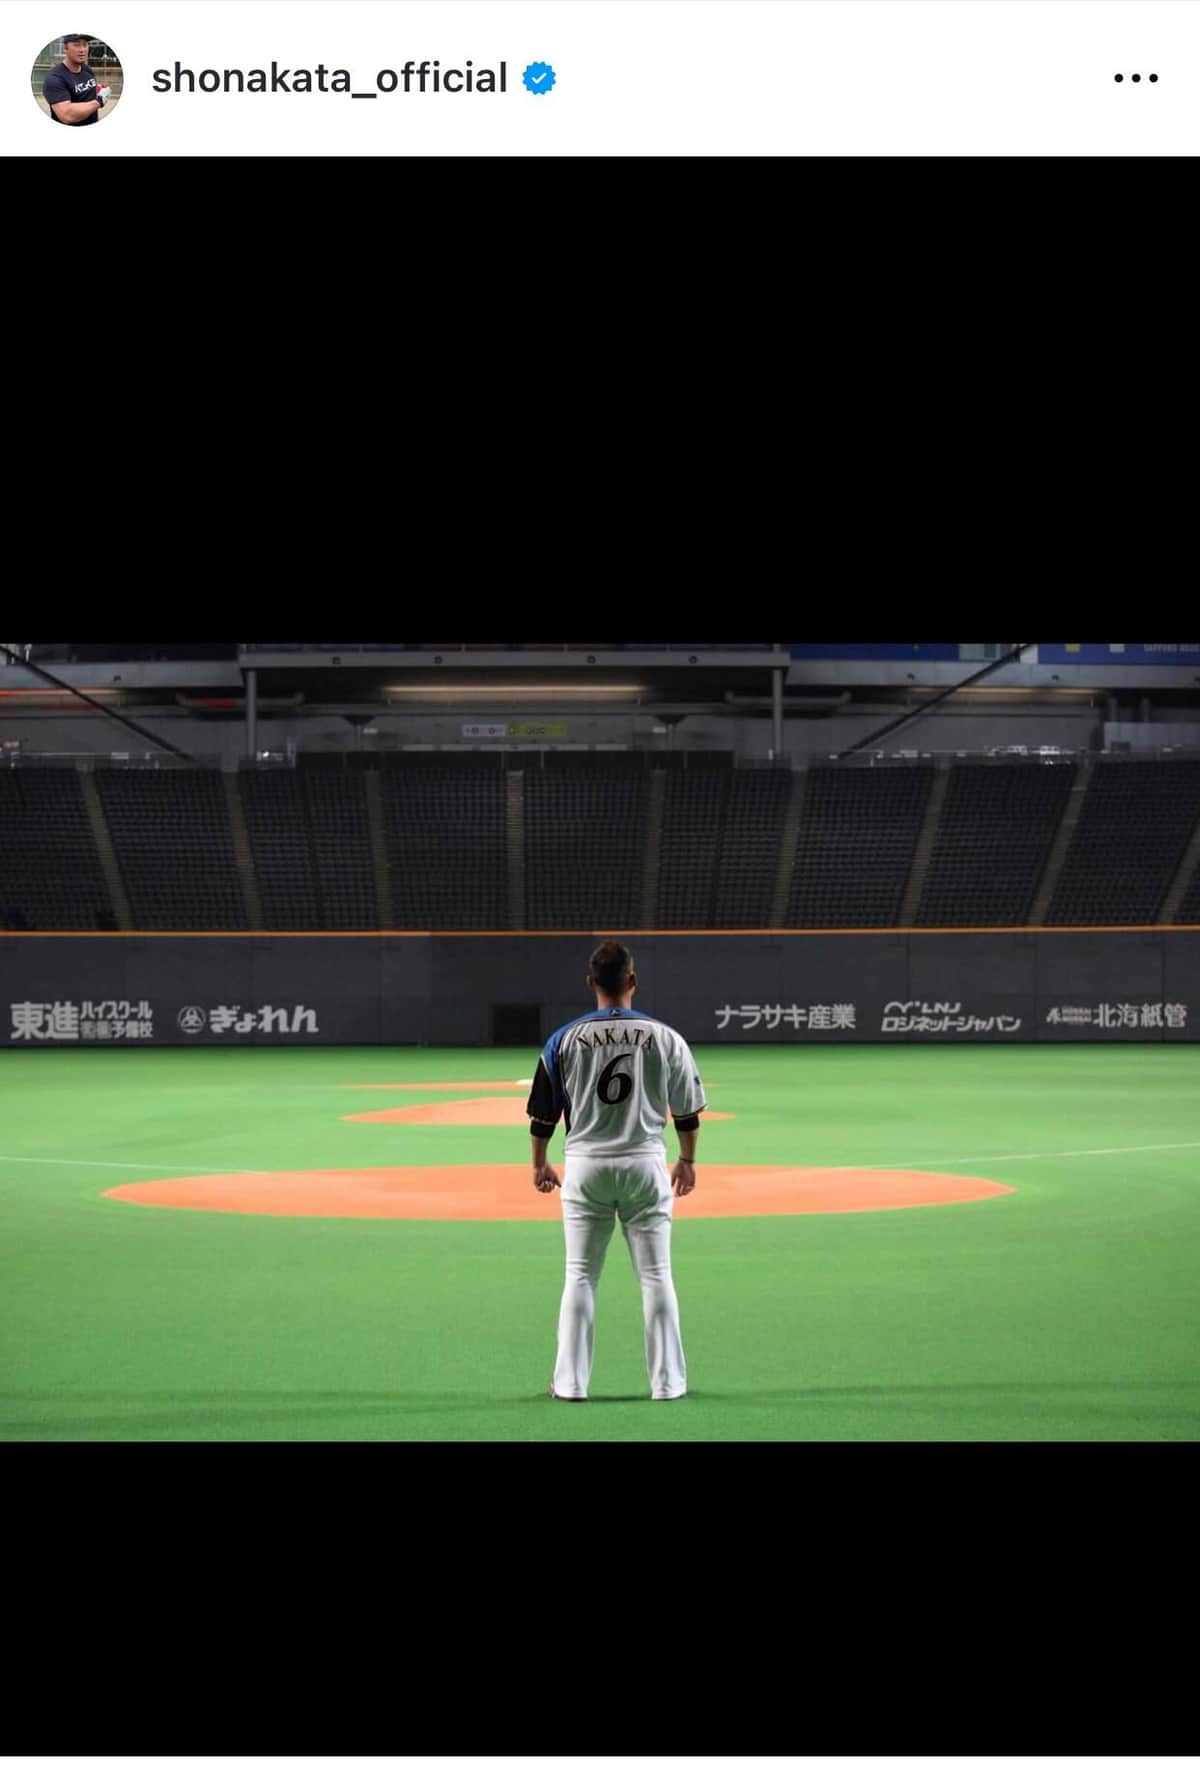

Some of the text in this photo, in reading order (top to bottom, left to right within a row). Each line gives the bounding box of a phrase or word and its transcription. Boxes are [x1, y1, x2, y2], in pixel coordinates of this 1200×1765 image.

[80, 1001, 153, 1019] ハイスクール
[209, 1005, 319, 1033] ぎょれん
[715, 1004, 856, 1029] ナラサキ産業
[922, 1003, 961, 1013] LNJ
[1093, 1003, 1187, 1028] 北海紙管
[10, 1001, 79, 1039] 東進
[80, 1020, 153, 1038] 予備校
[881, 1016, 1021, 1031] ロジネットジャパン
[577, 1028, 654, 1050] NAKATA
[597, 1053, 633, 1105] 6
